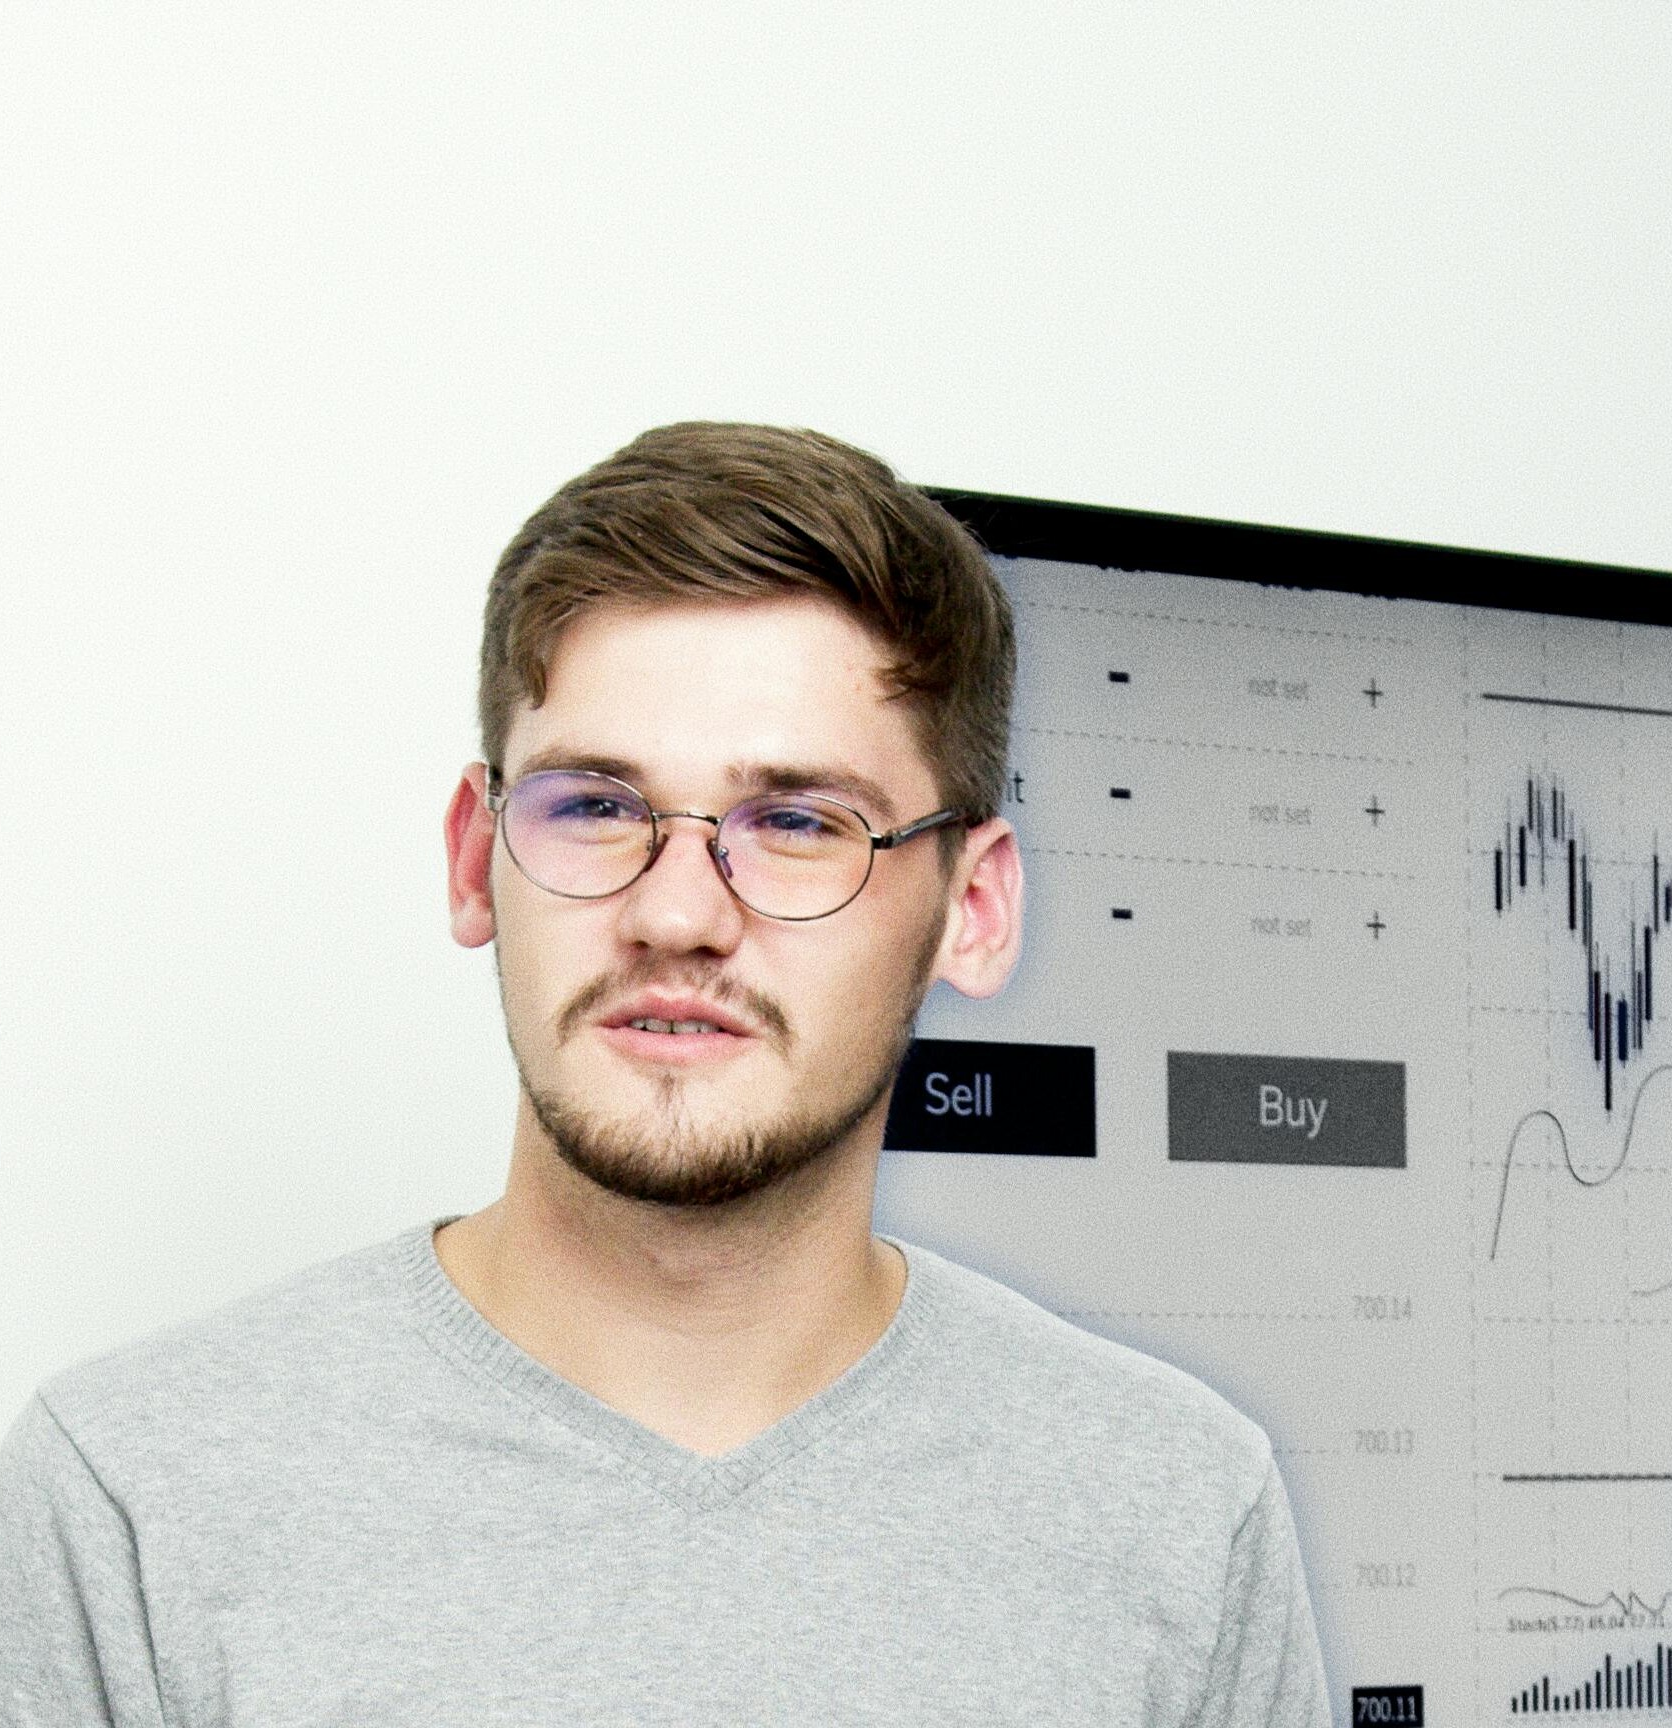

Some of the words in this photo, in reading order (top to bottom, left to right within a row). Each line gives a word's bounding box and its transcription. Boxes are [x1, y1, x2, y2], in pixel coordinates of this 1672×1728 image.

[924, 1072, 993, 1117] Sell
[1258, 1084, 1328, 1138] Buy
[1352, 1295, 1412, 1320] 700.14
[1354, 1429, 1414, 1454] 700.13
[1357, 1696, 1417, 1722] 700.11
